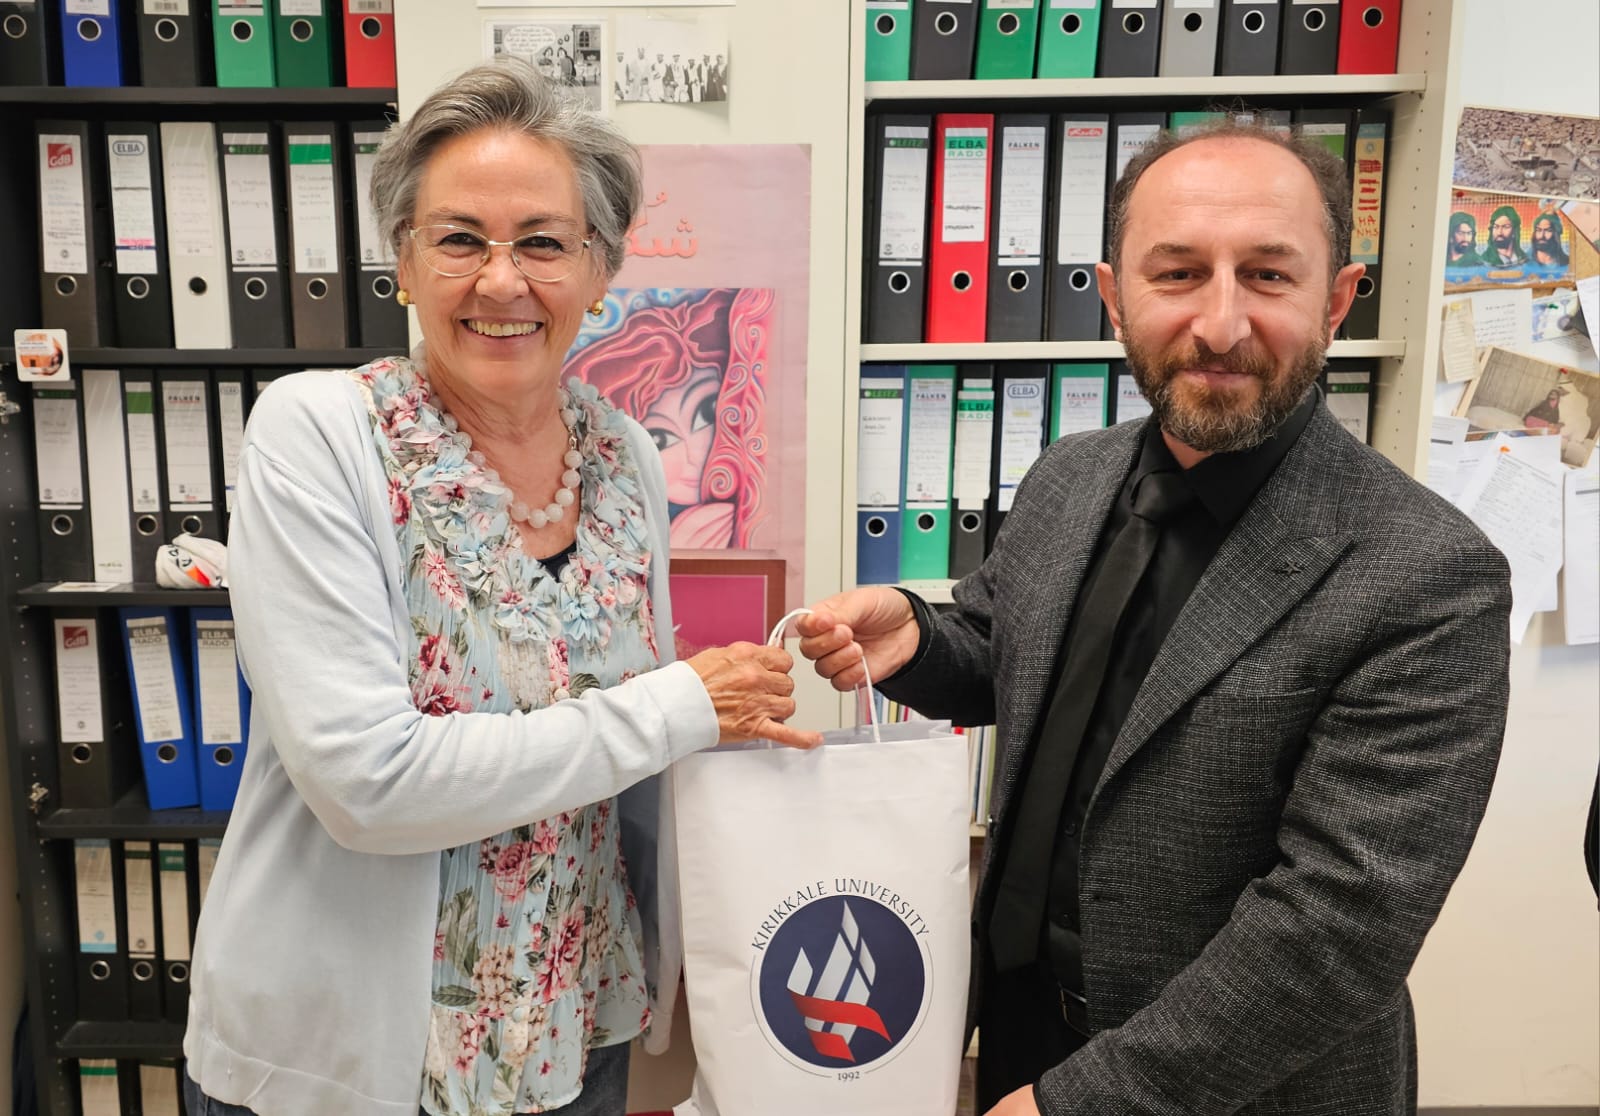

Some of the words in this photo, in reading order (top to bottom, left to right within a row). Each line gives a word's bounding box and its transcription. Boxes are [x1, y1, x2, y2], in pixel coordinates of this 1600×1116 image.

[117, 143, 141, 153] ELBA
[948, 139, 984, 149] ELBA
[948, 150, 984, 158] RADO
[1012, 386, 1035, 396] ELBA
[959, 402, 992, 411] ELBA
[133, 627, 161, 637] ELBA
[202, 631, 229, 640] ELBA
[135, 636, 162, 645] RADO
[752, 880, 828, 951] KIRIKKALE
[835, 878, 930, 937] UNIVERSITY
[837, 1071, 861, 1082] 1992
